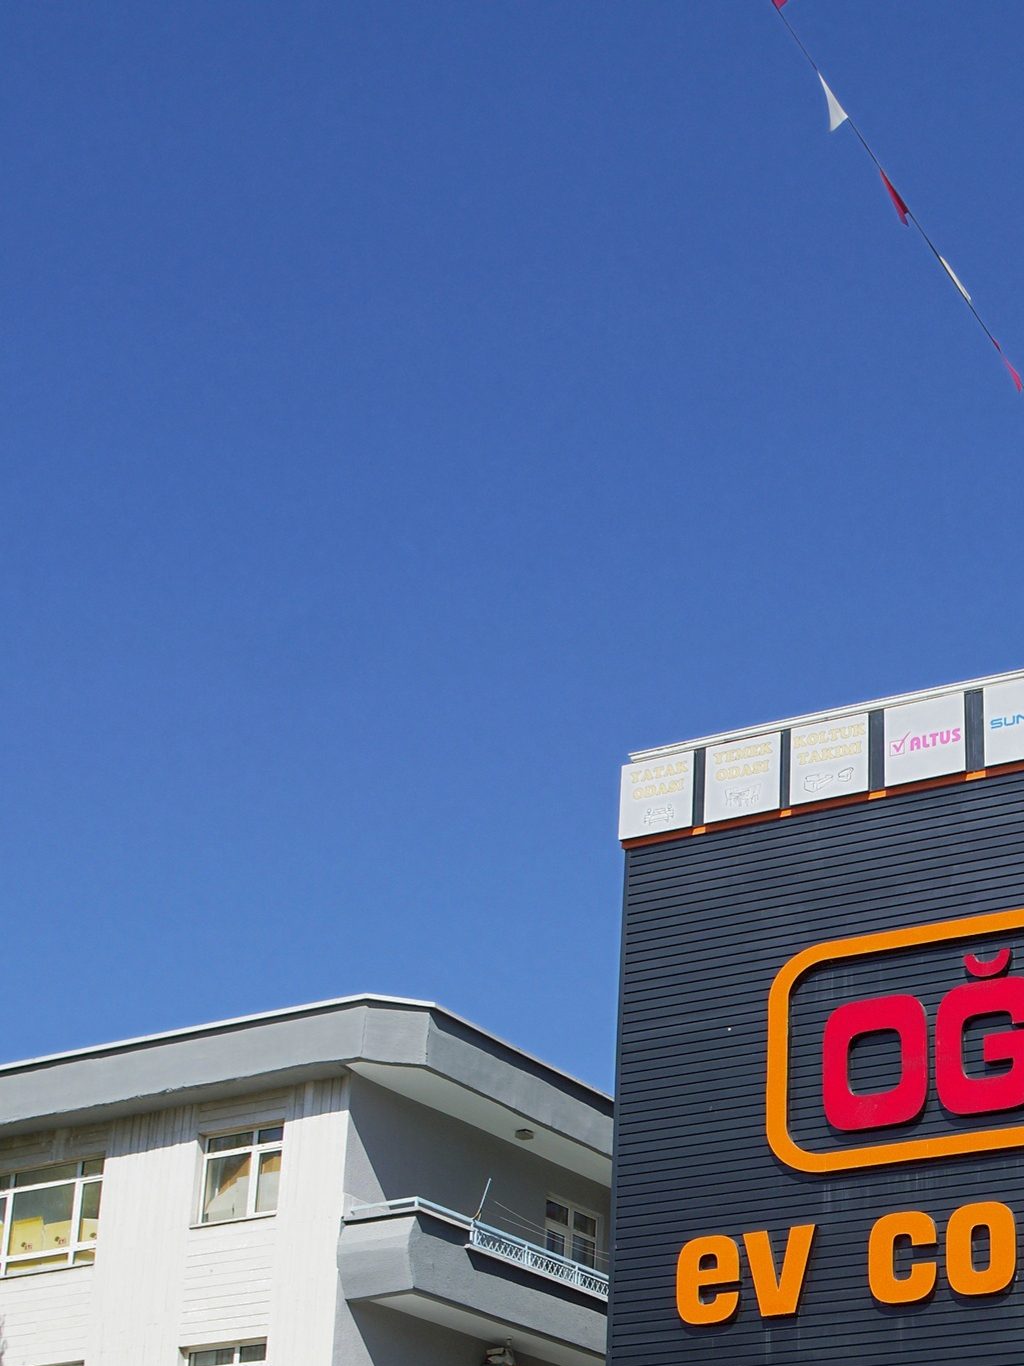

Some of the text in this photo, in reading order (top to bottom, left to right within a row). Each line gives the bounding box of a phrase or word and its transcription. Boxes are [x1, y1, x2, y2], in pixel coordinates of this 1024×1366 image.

[793, 723, 865, 748] KOLTUK
[910, 727, 961, 751] ALTUS
[713, 742, 773, 765] YEMEK
[798, 741, 862, 765] TAKIMI
[630, 760, 689, 784] YATAK
[715, 760, 769, 781] ODASI
[633, 779, 685, 800] ODASI
[676, 1224, 815, 1325] ev
